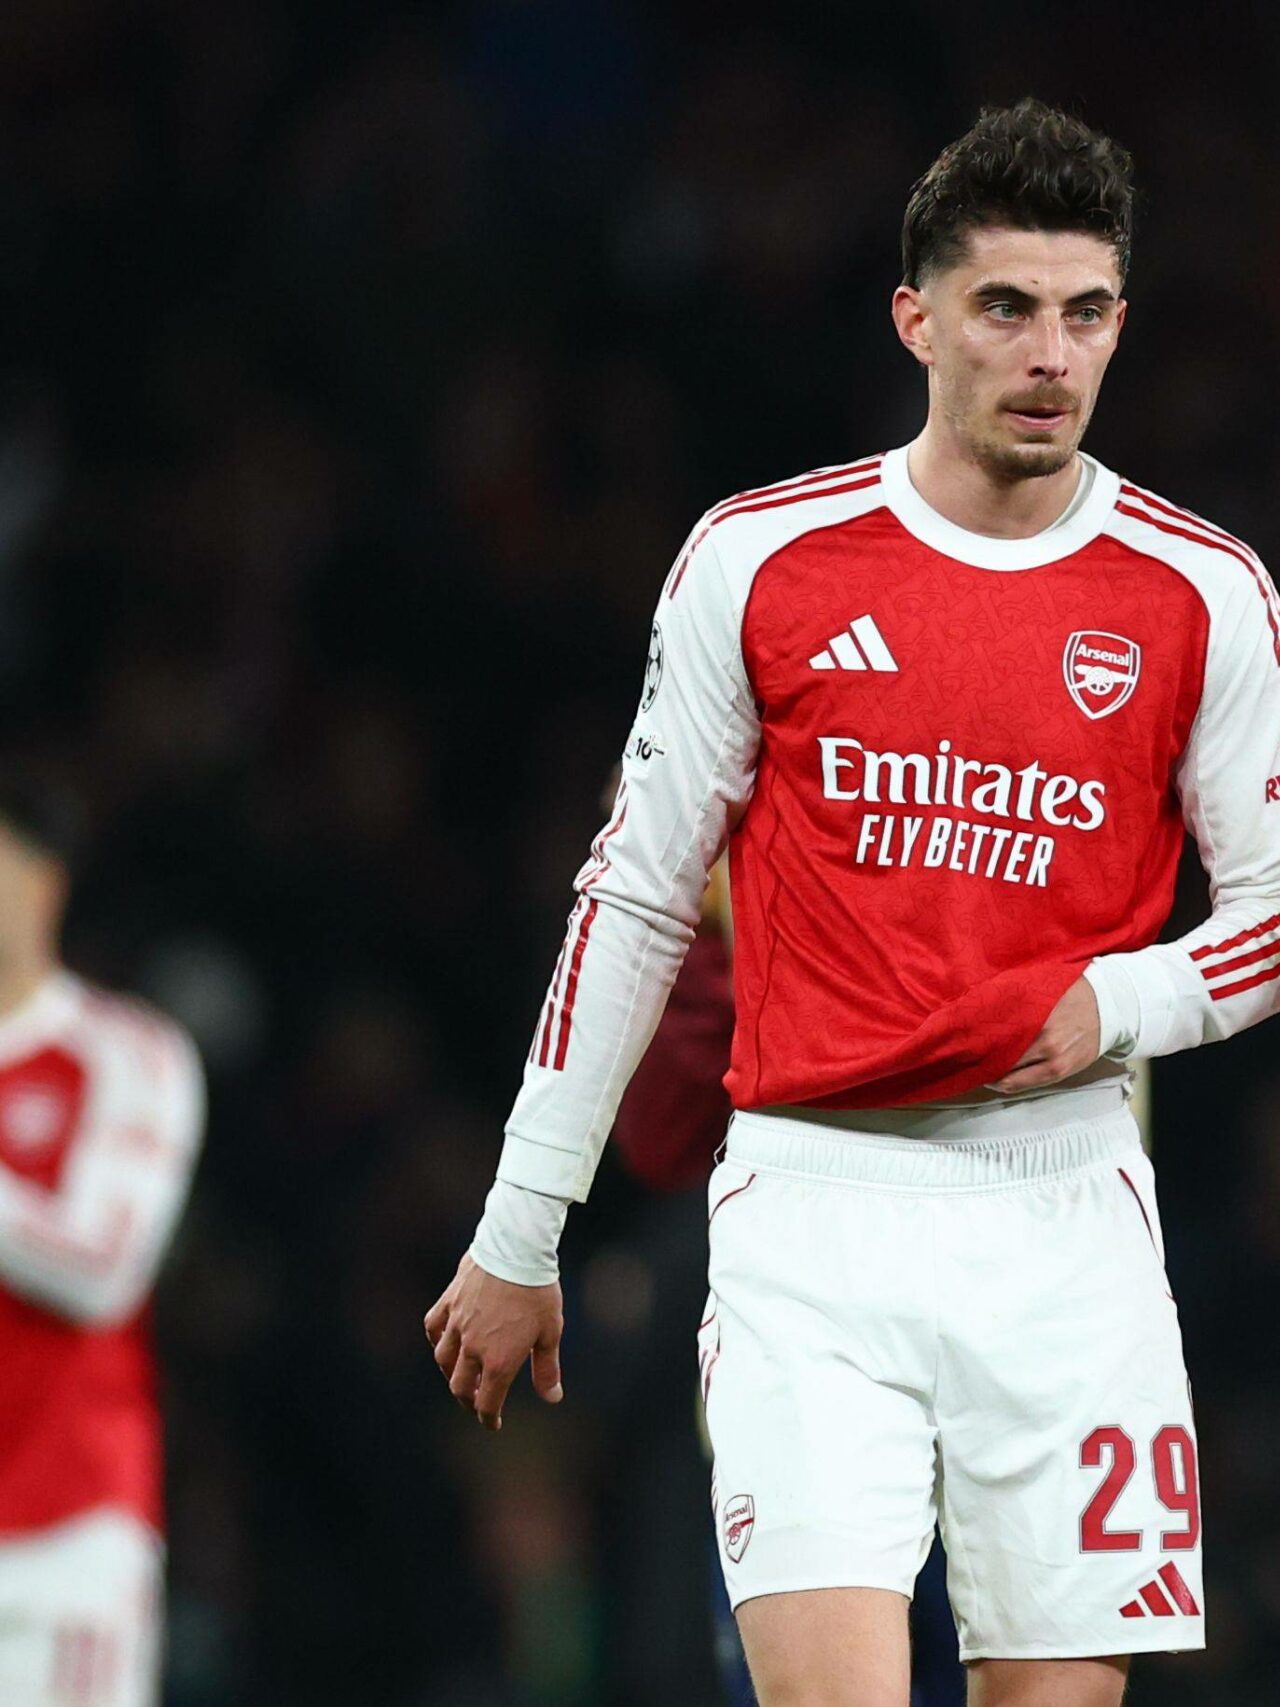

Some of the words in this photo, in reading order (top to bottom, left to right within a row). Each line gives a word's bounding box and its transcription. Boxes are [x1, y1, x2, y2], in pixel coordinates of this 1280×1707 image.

[1076, 643, 1130, 667] Arsenal
[816, 736, 1106, 831] Emirates
[855, 813, 924, 868] FLY
[923, 817, 1056, 888] BETTER
[1079, 1424, 1200, 1553] 29
